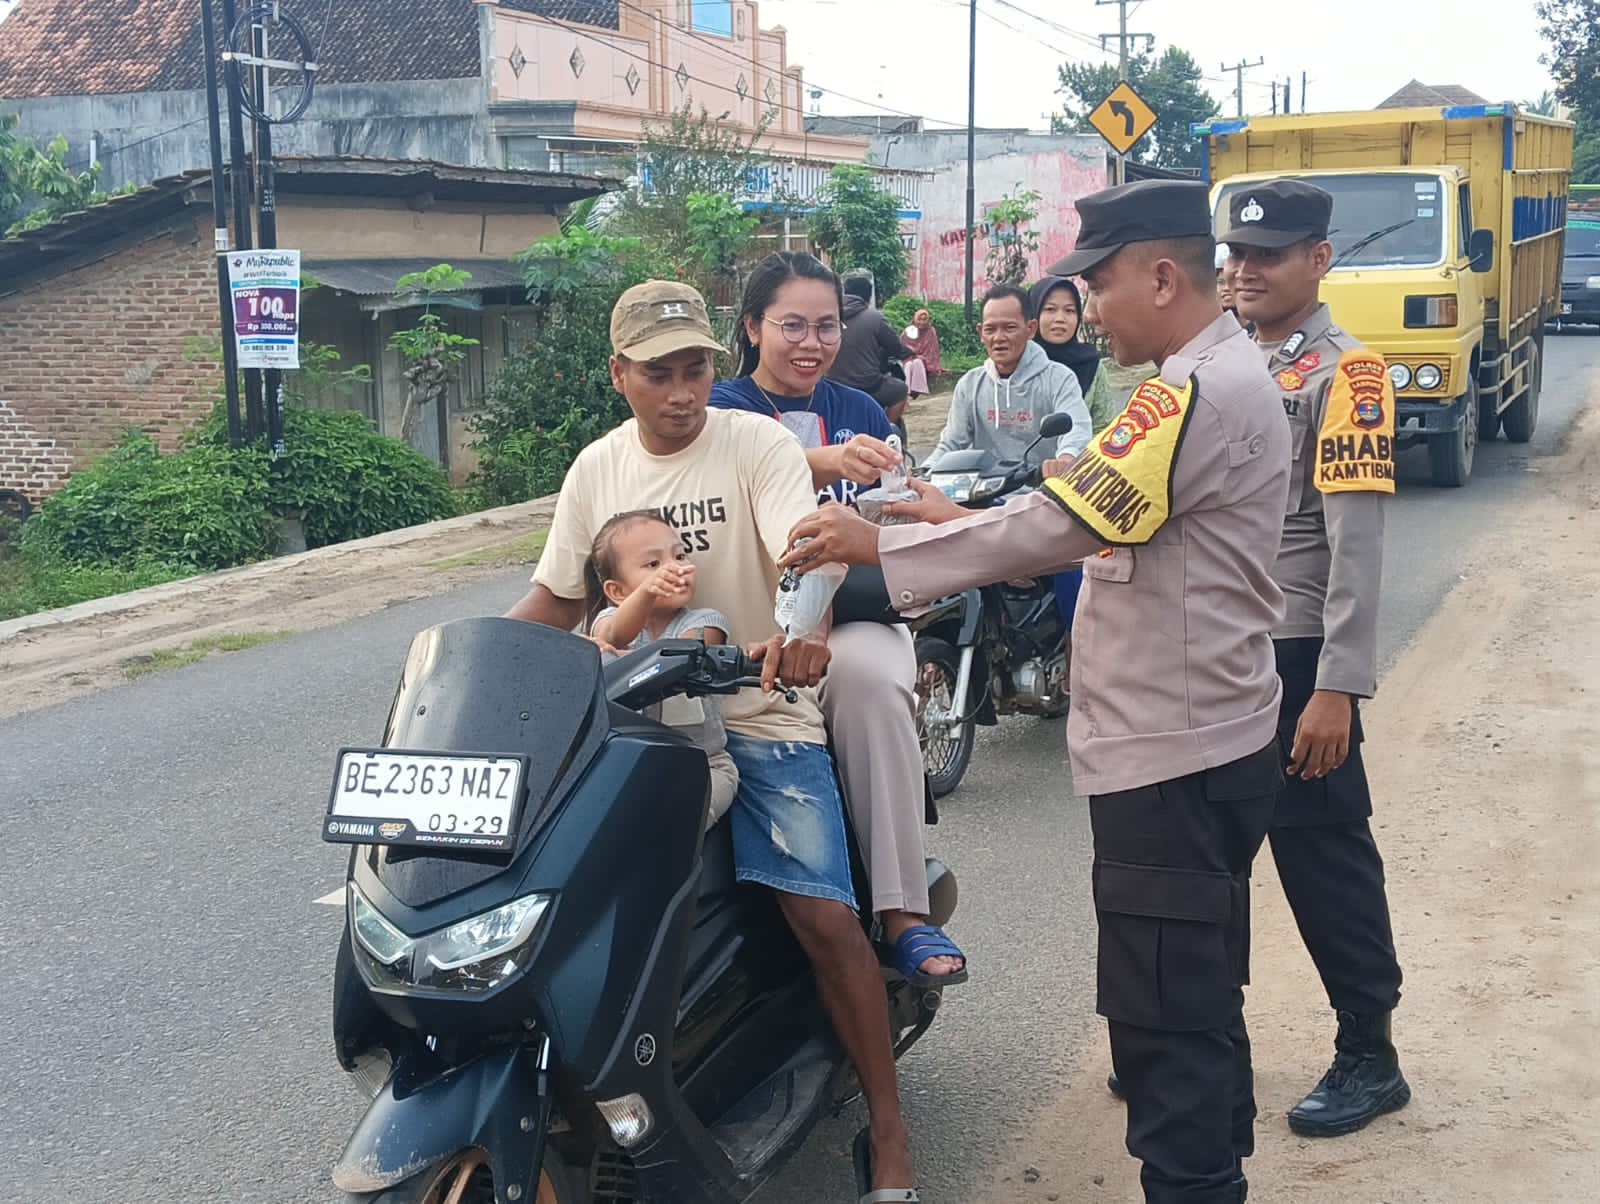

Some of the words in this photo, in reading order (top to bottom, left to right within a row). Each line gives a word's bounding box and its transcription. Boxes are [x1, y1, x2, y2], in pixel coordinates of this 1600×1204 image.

[246, 255, 295, 269] MyRepublic
[236, 289, 259, 298] NOVA
[249, 297, 284, 316] 100
[247, 322, 259, 332] Rp
[817, 479, 857, 505] AR
[661, 497, 728, 530] KING
[344, 762, 380, 794] BE
[383, 763, 454, 796] 2363
[460, 767, 512, 801] NAZ
[338, 822, 375, 837] YAMAHA
